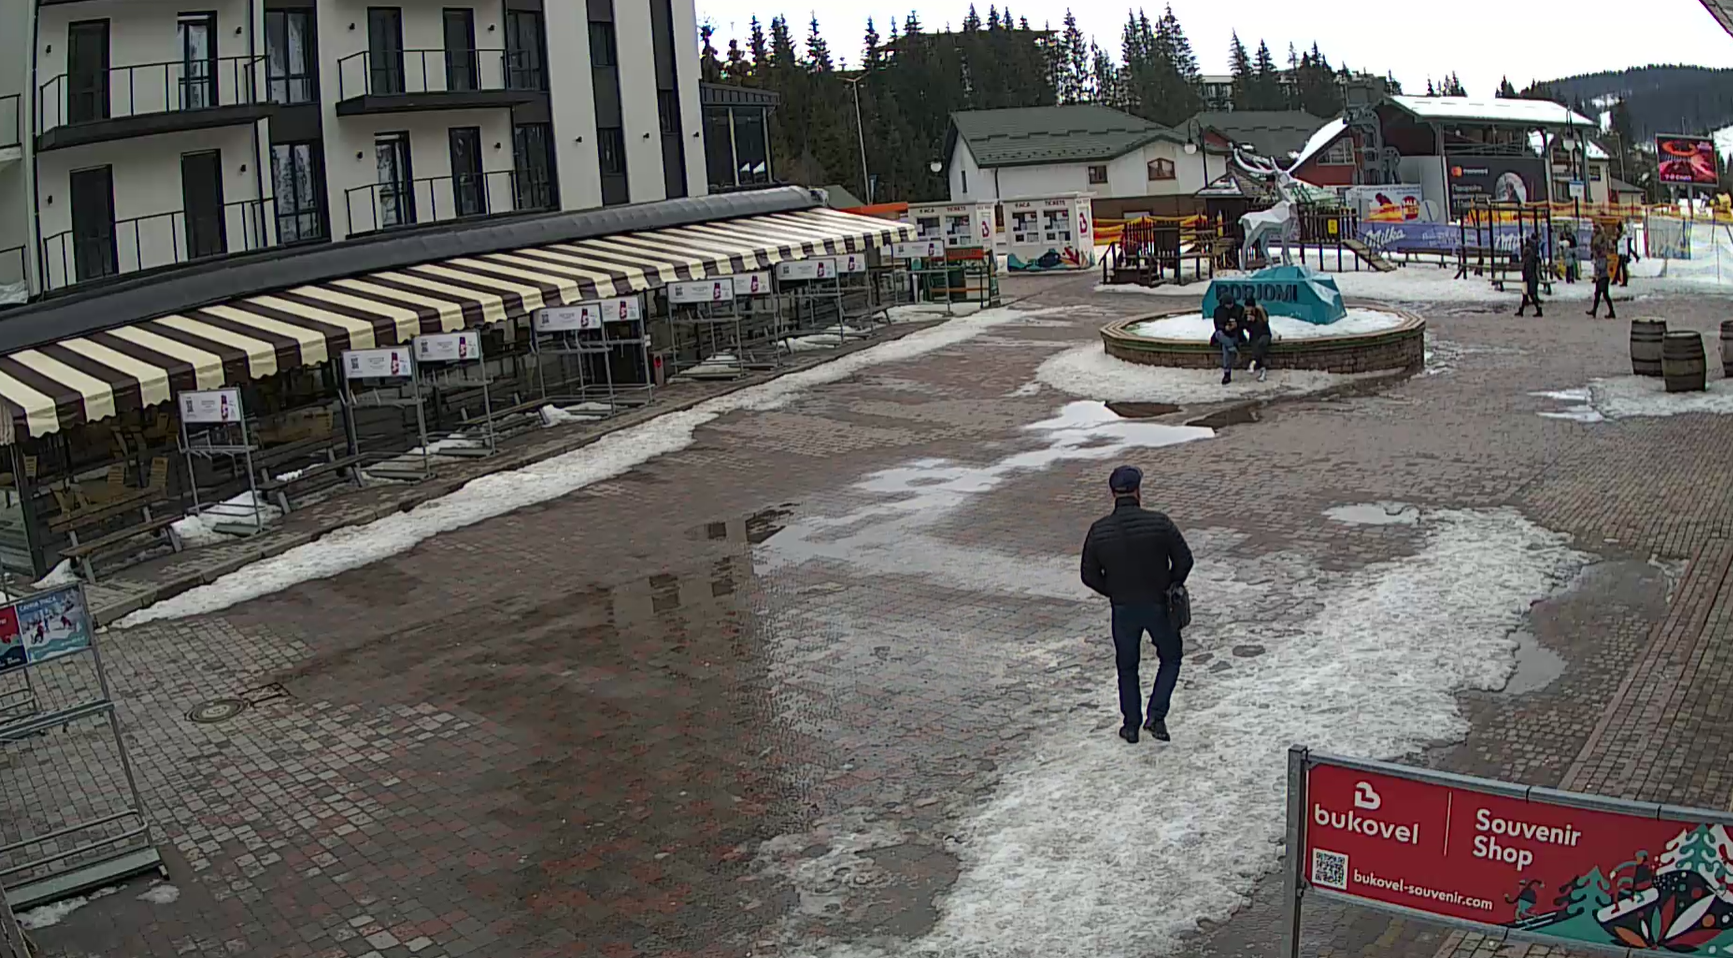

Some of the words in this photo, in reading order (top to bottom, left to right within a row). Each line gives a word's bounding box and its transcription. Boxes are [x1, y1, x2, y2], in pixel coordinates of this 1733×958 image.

[1363, 224, 1406, 249] Milka
[1215, 283, 1298, 303] BORJOMI
[1313, 803, 1420, 845] bukovel
[1474, 808, 1582, 848] Souvenir
[1472, 835, 1534, 871] Shop
[1352, 869, 1493, 912] bukovel-souvenir.com
